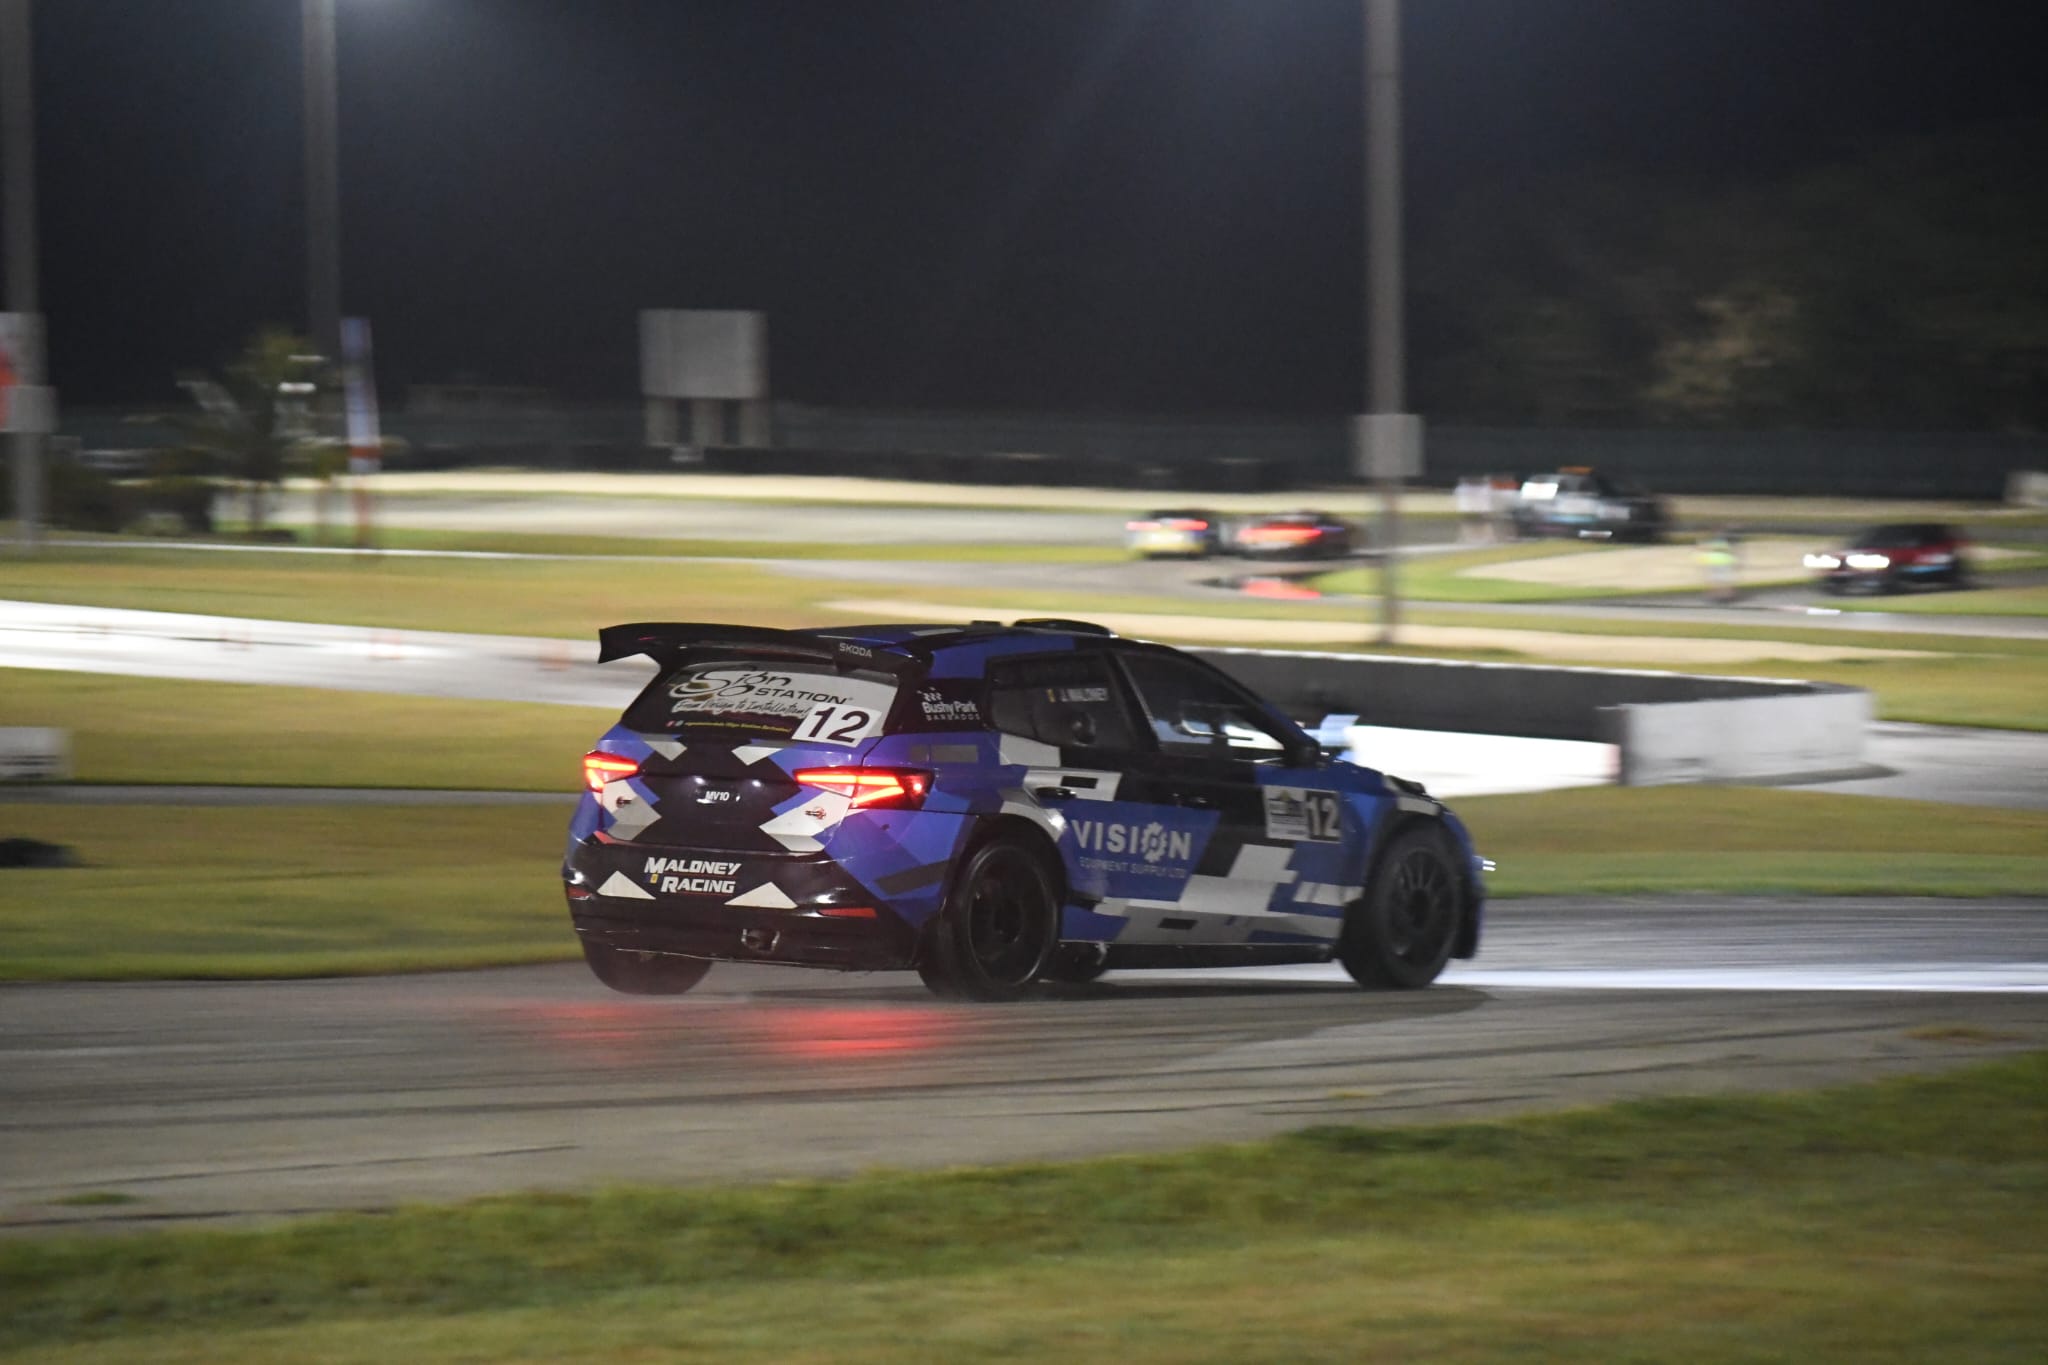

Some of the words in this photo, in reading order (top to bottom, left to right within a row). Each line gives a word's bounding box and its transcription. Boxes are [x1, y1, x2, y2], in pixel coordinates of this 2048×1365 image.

[674, 665, 792, 697] Sign
[736, 698, 747, 710] to
[754, 687, 848, 704] STATION
[921, 701, 954, 716] Bushy
[953, 700, 978, 713] Park
[807, 706, 870, 743] 12
[1305, 796, 1341, 837] 12
[1071, 819, 1192, 863] VISION
[643, 856, 742, 876] MALONEY
[660, 876, 737, 894] RACING
